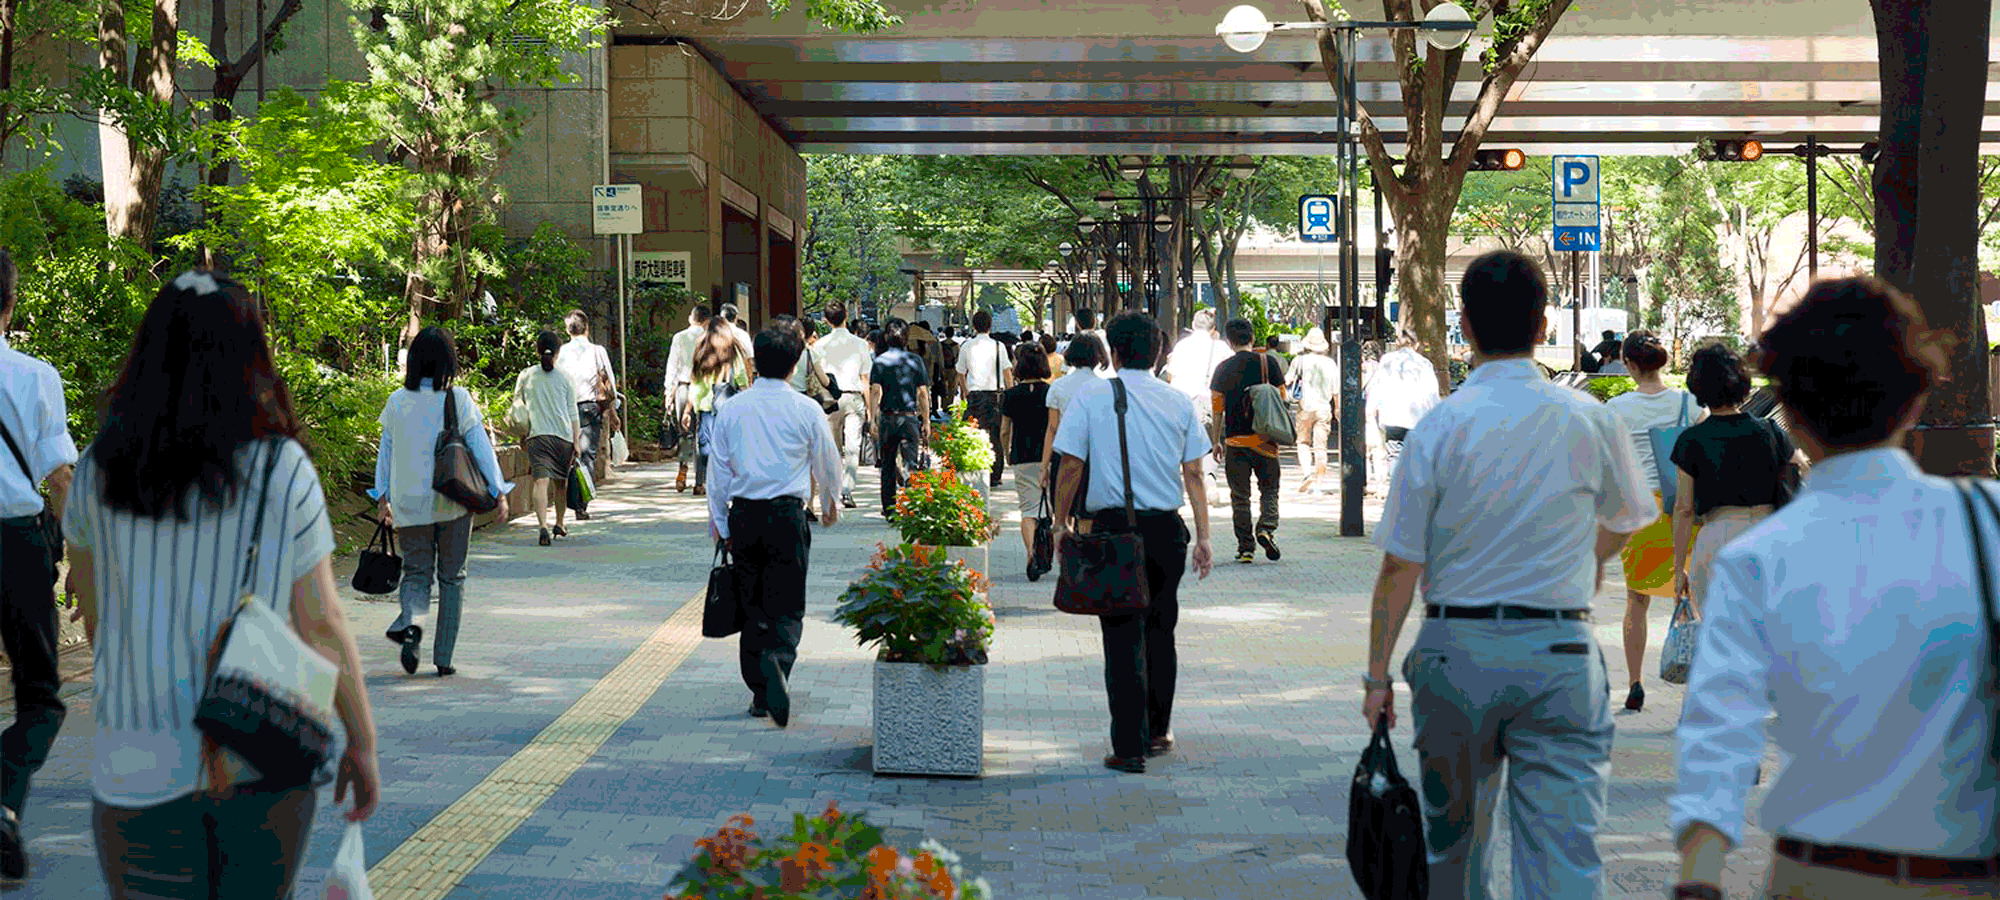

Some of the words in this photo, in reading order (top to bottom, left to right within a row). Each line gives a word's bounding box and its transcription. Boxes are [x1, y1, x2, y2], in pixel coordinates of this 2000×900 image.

[1563, 162, 1590, 197] P
[1579, 232, 1596, 246] IN
[634, 259, 686, 278] 都庁大型車駐車場
